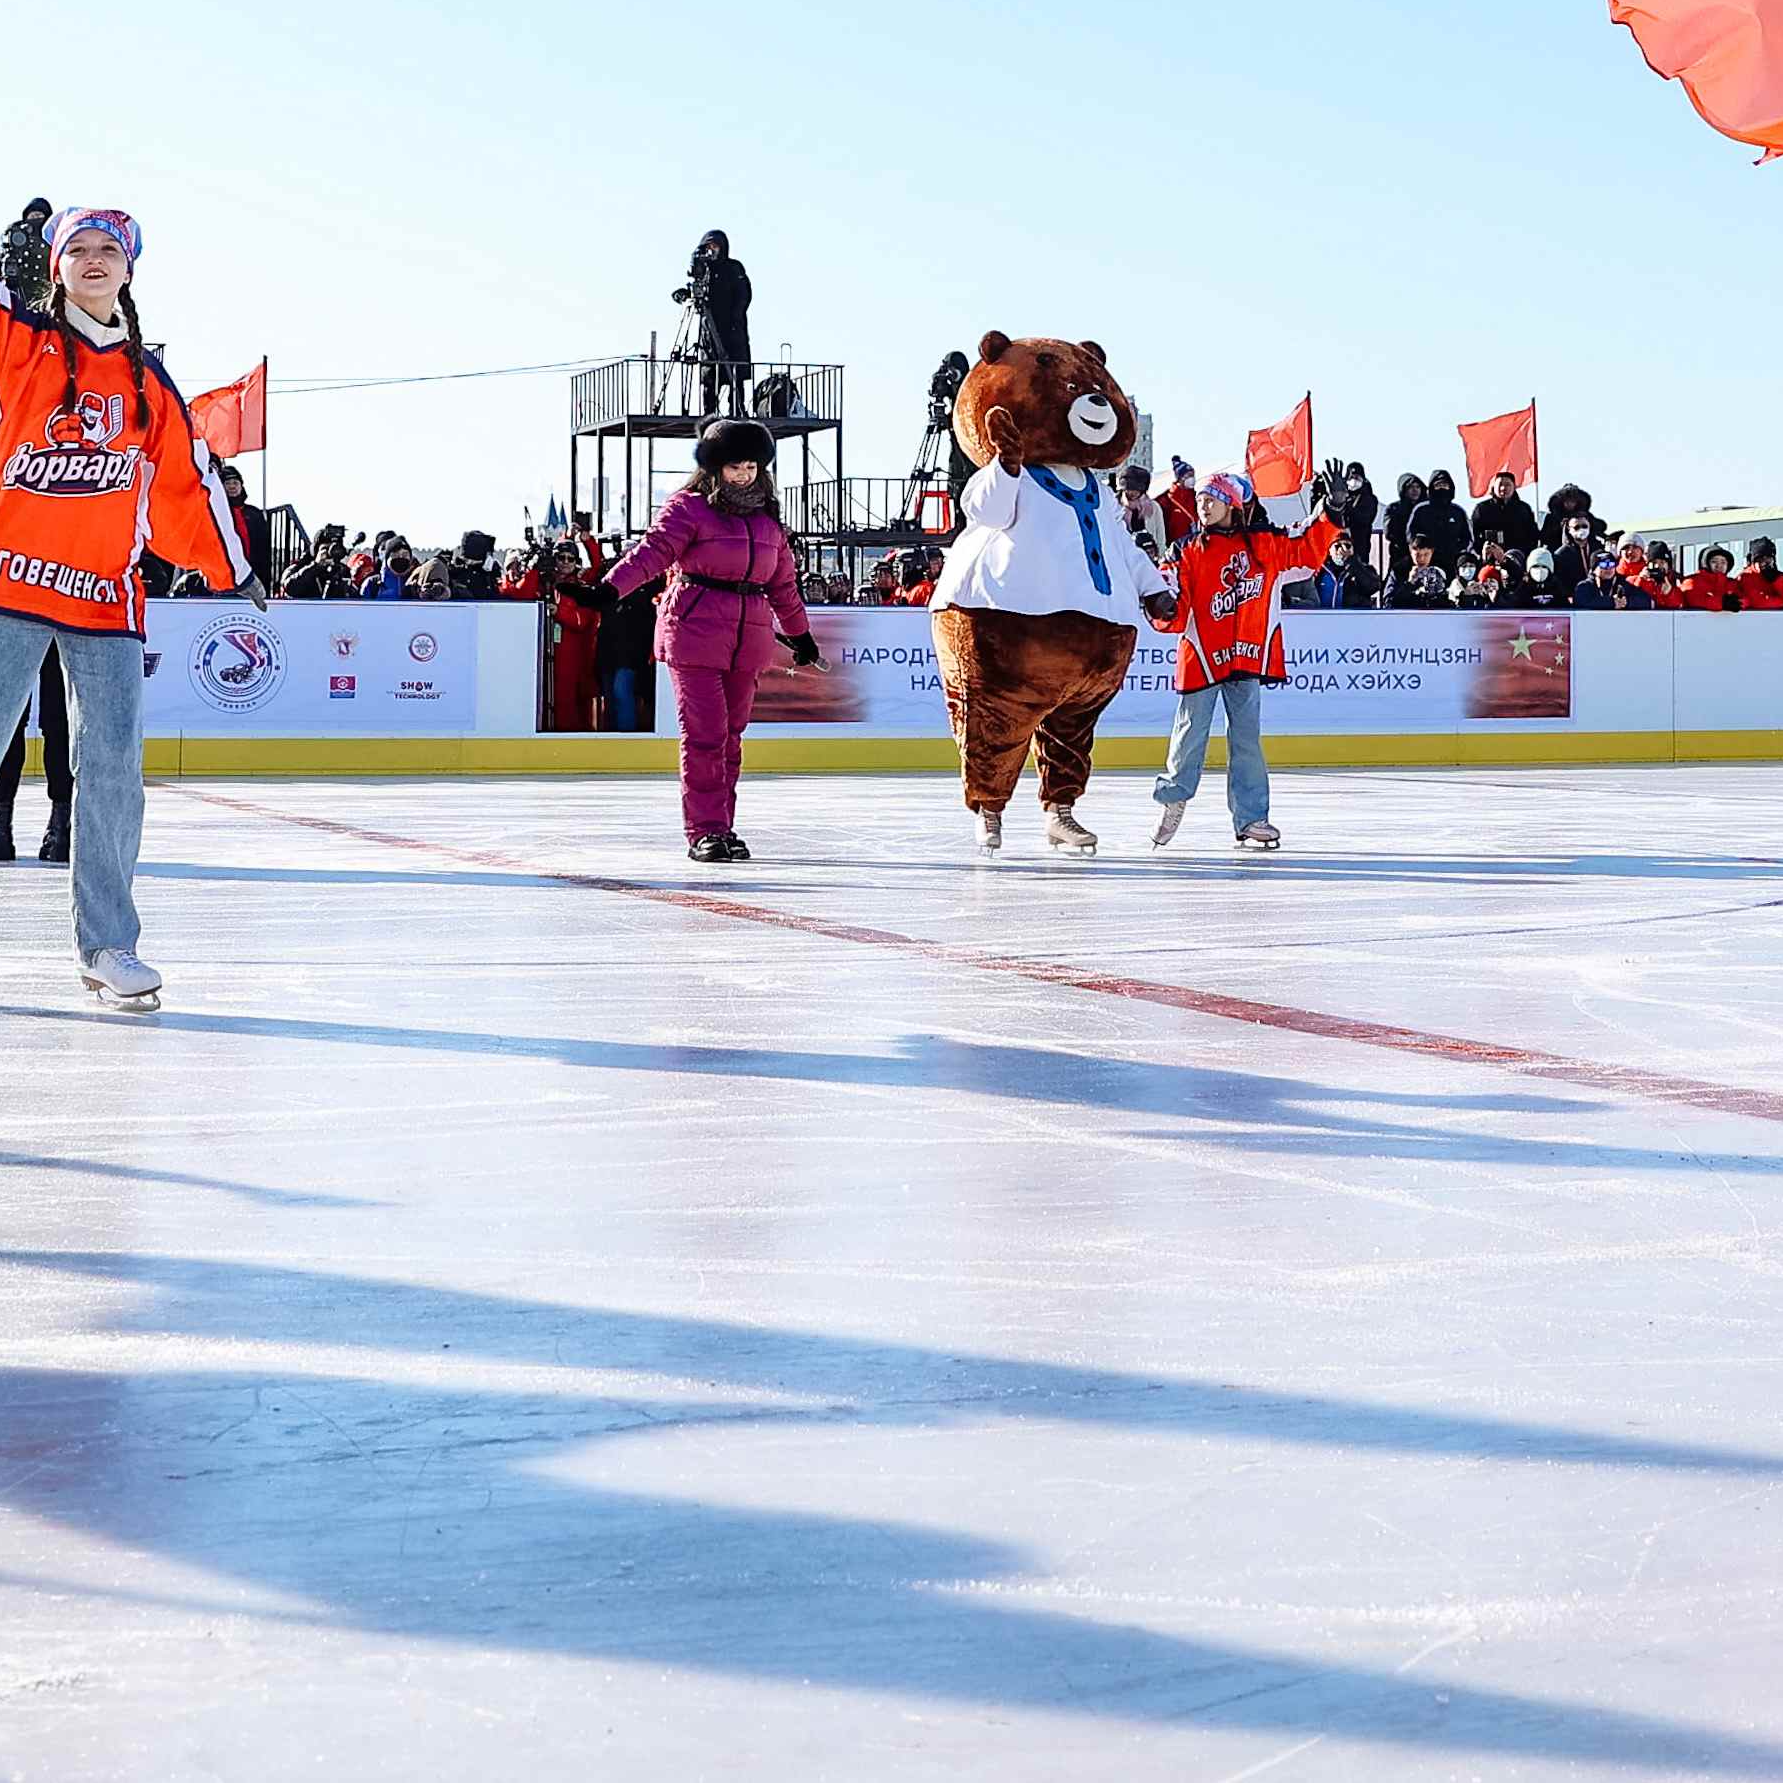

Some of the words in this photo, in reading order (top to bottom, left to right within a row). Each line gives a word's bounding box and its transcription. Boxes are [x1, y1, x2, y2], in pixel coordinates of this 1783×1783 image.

[842, 648, 937, 667] НАРОДН
[1336, 644, 1482, 666] ХЭЙЛУНЦЗЯН
[400, 681, 433, 691] SHOW
[1269, 673, 1338, 692] РОДА
[1346, 670, 1421, 690] ХЭЙХЭ
